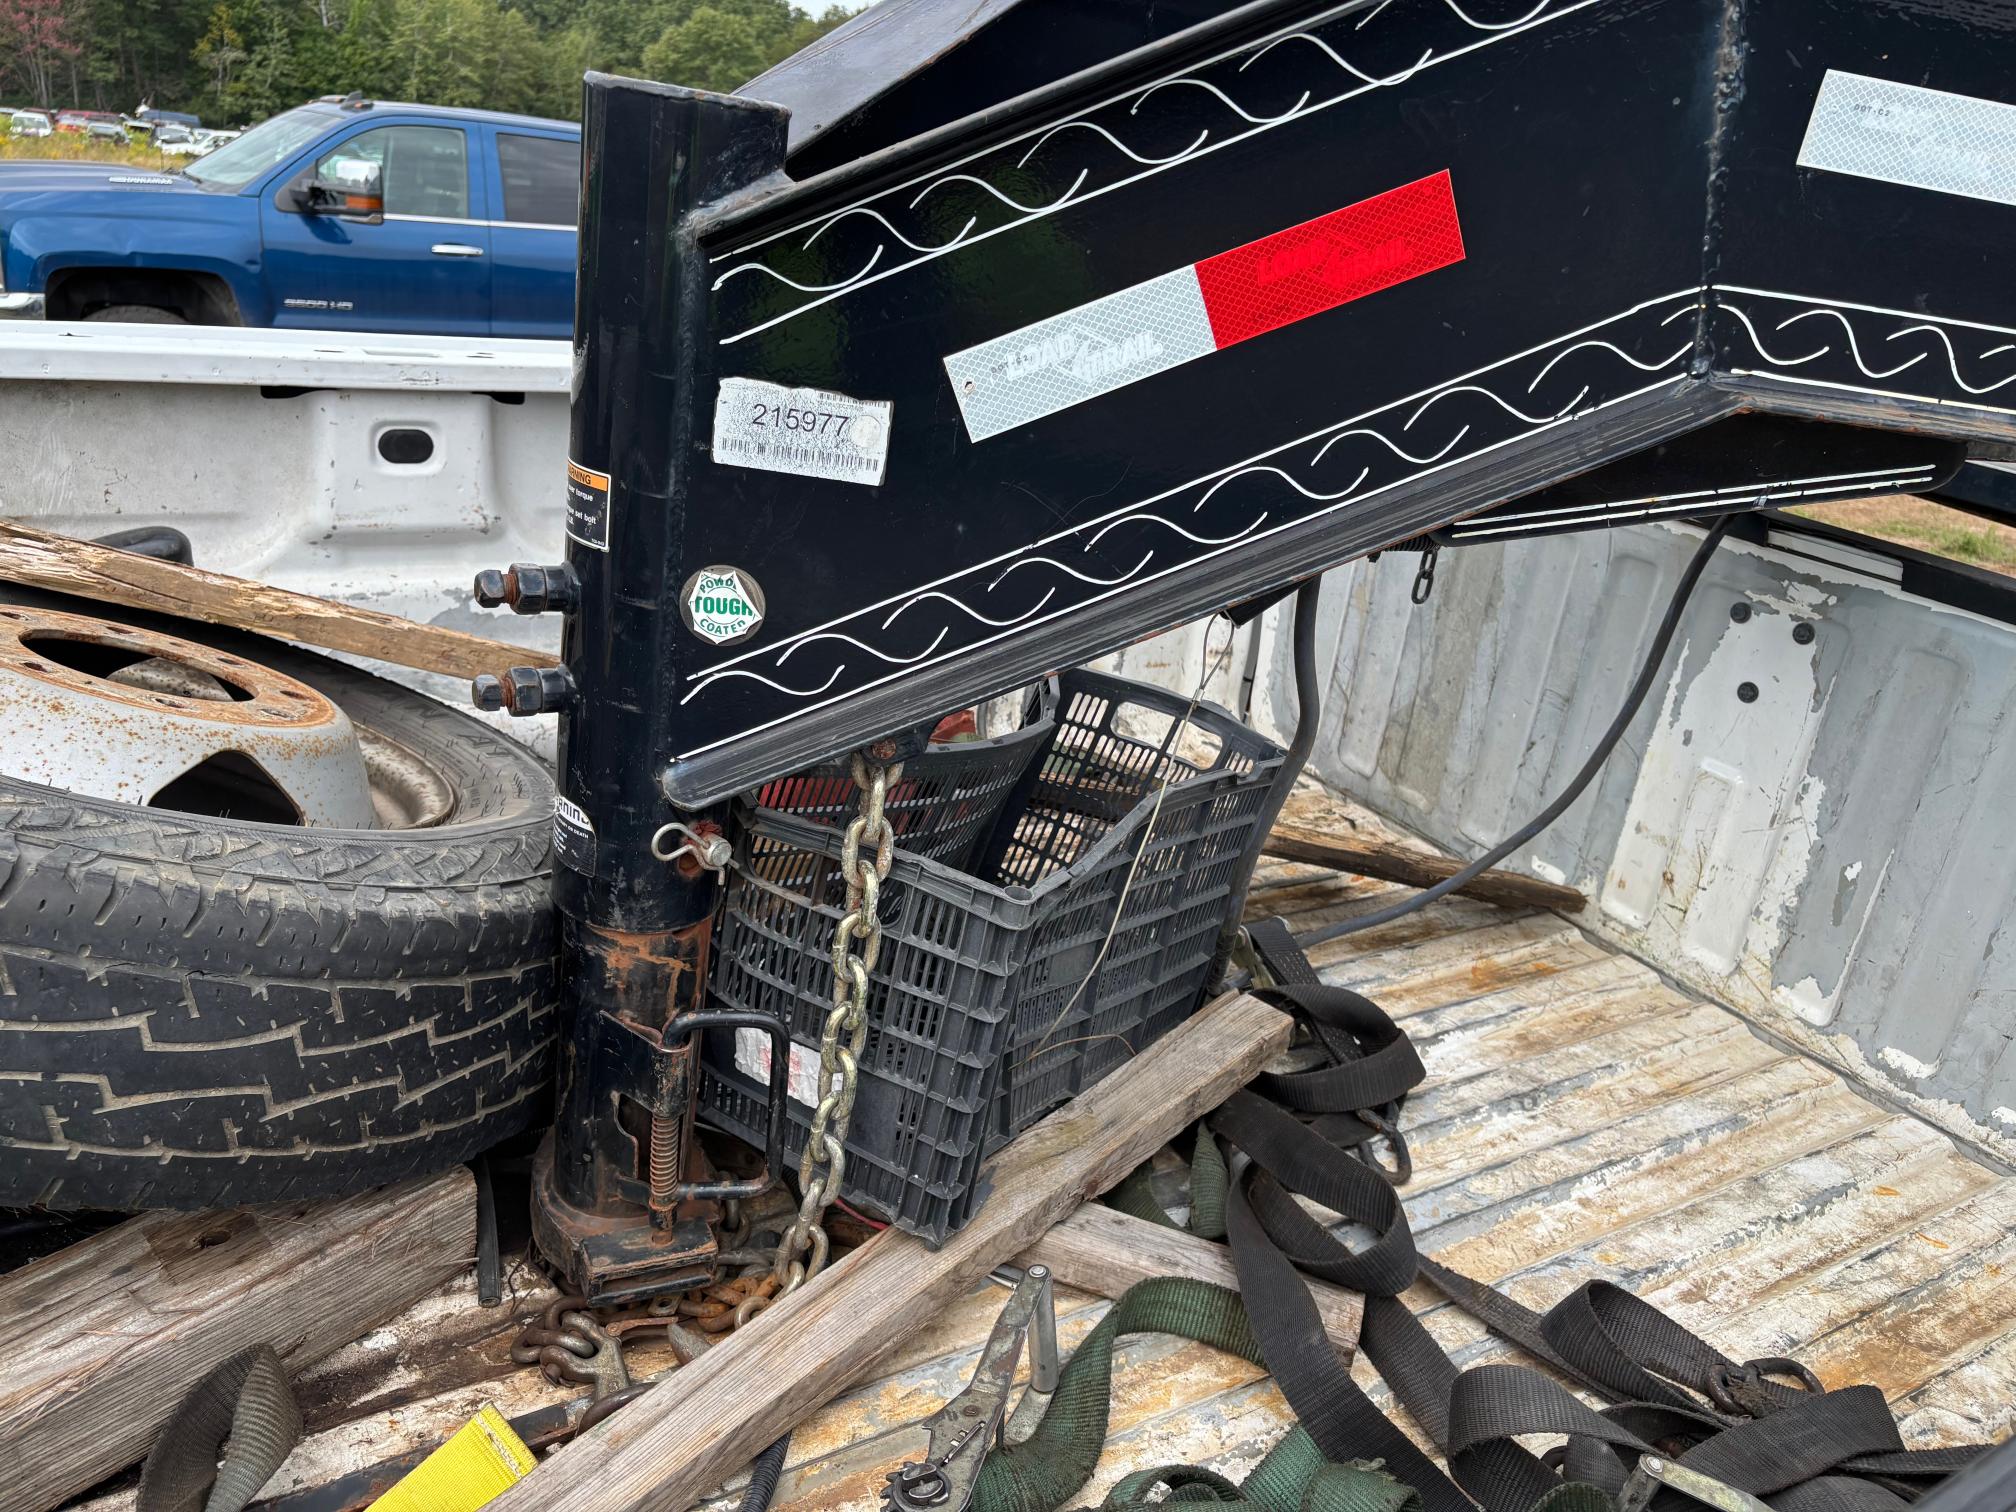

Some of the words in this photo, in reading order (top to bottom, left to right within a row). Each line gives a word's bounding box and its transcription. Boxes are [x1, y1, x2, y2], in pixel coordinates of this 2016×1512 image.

[1005, 331, 1077, 381] LOAD
[1086, 329, 1164, 381] TRAIL
[752, 403, 849, 437] 215977
[575, 488, 594, 502] torque
[584, 513, 597, 525] bolt
[694, 595, 753, 617] TOUGH
[573, 828, 589, 839] DEATH
